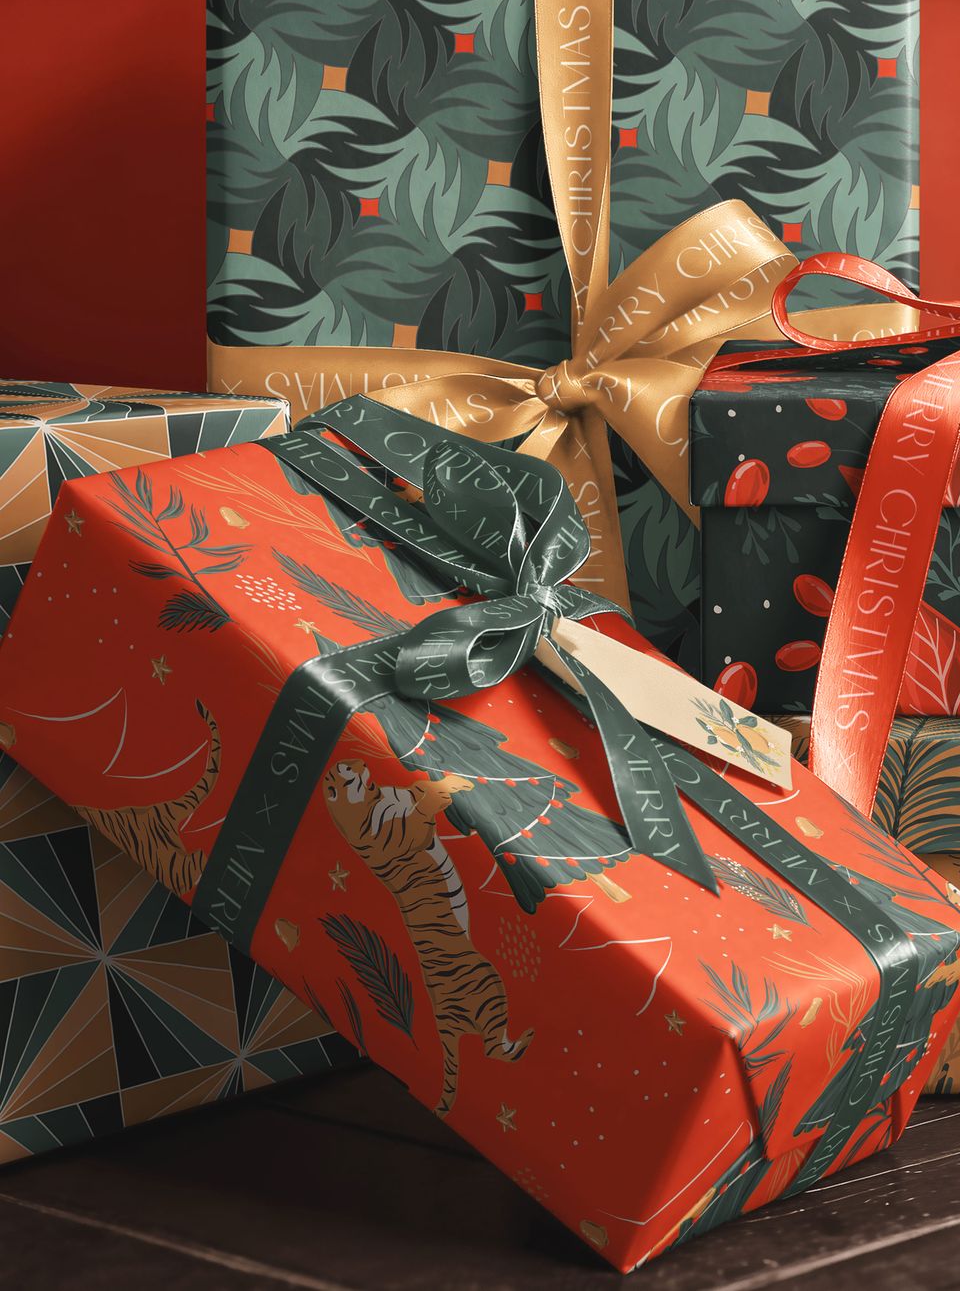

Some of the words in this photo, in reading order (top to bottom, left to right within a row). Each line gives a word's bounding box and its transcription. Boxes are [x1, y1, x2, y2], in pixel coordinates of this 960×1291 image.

[558, 4, 594, 257] CHRISTMAS
[676, 216, 777, 279] CHRIS
[836, 488, 918, 734] CHRISTMAS
[616, 733, 689, 865] MERRY
[704, 796, 829, 887] MERRY
